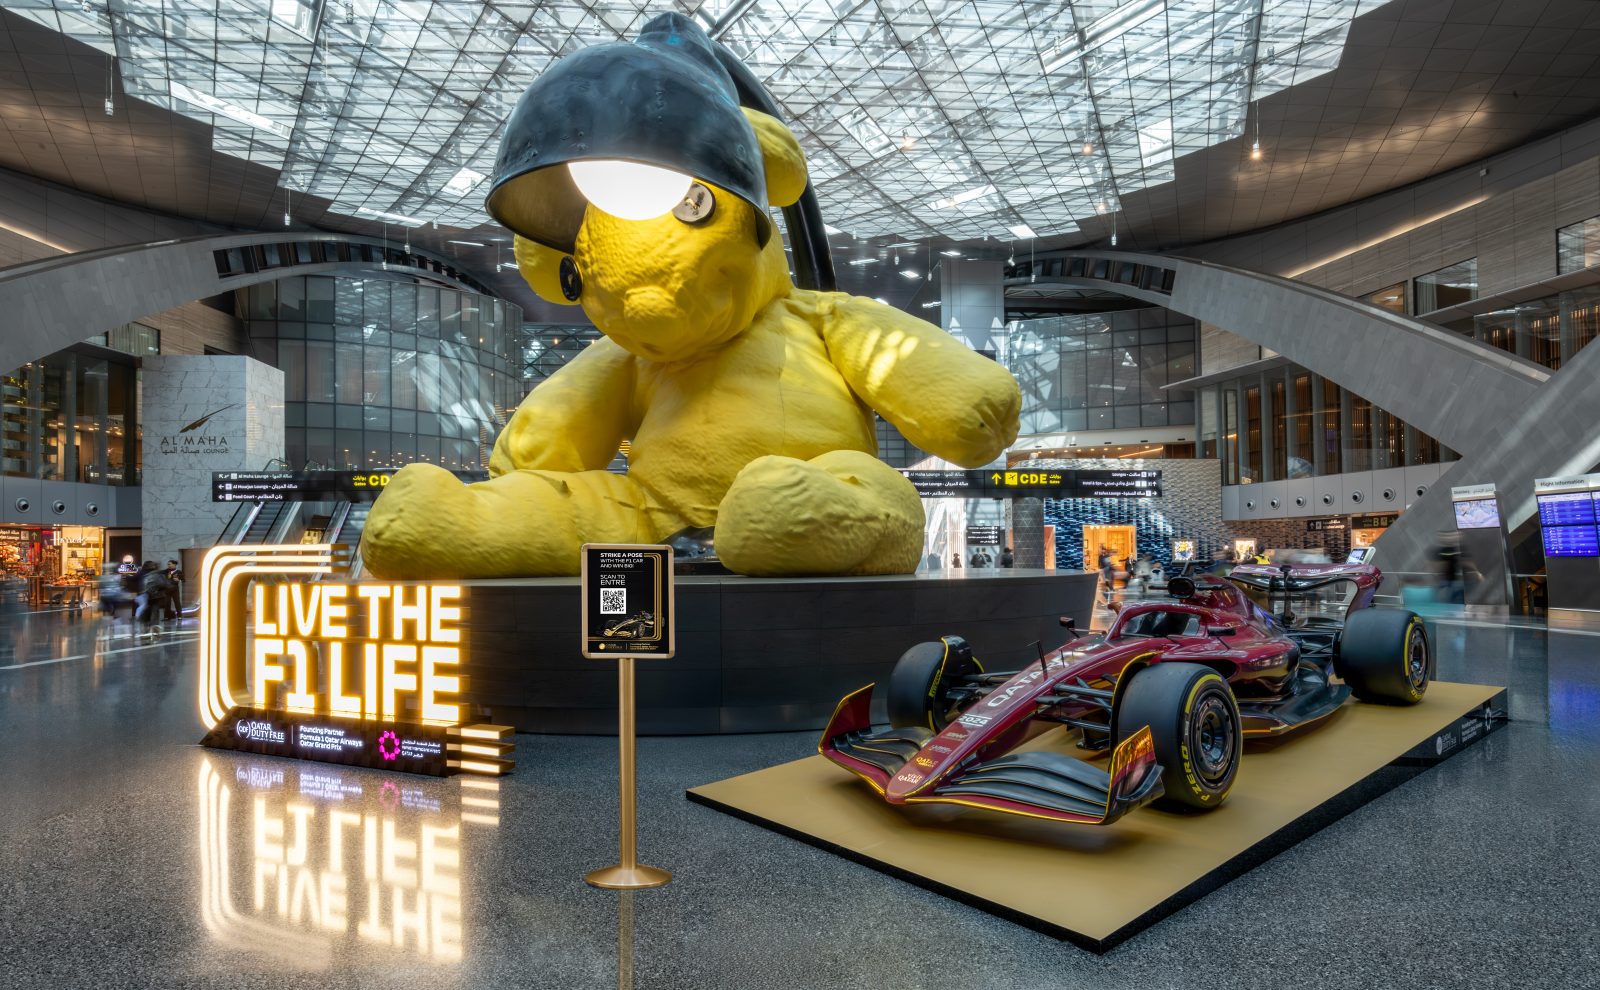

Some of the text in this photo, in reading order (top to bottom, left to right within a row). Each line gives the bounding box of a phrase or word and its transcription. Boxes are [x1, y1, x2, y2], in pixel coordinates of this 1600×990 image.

[161, 436, 228, 445] AL MAHA
[369, 475, 391, 486] CD
[1020, 473, 1047, 484] CDE
[255, 584, 461, 642] LIVE THE
[255, 639, 460, 725] F1 LIFE
[251, 721, 272, 731] QATAR
[251, 730, 269, 739] DUTY
[269, 731, 285, 740] FREE
[324, 728, 345, 736] Partner
[300, 733, 320, 742] Formula
[325, 736, 340, 744] Qatar
[340, 738, 363, 747] Airways
[300, 740, 342, 751] Qatar Grand Prix
[1180, 744, 1210, 801] P ZERO
